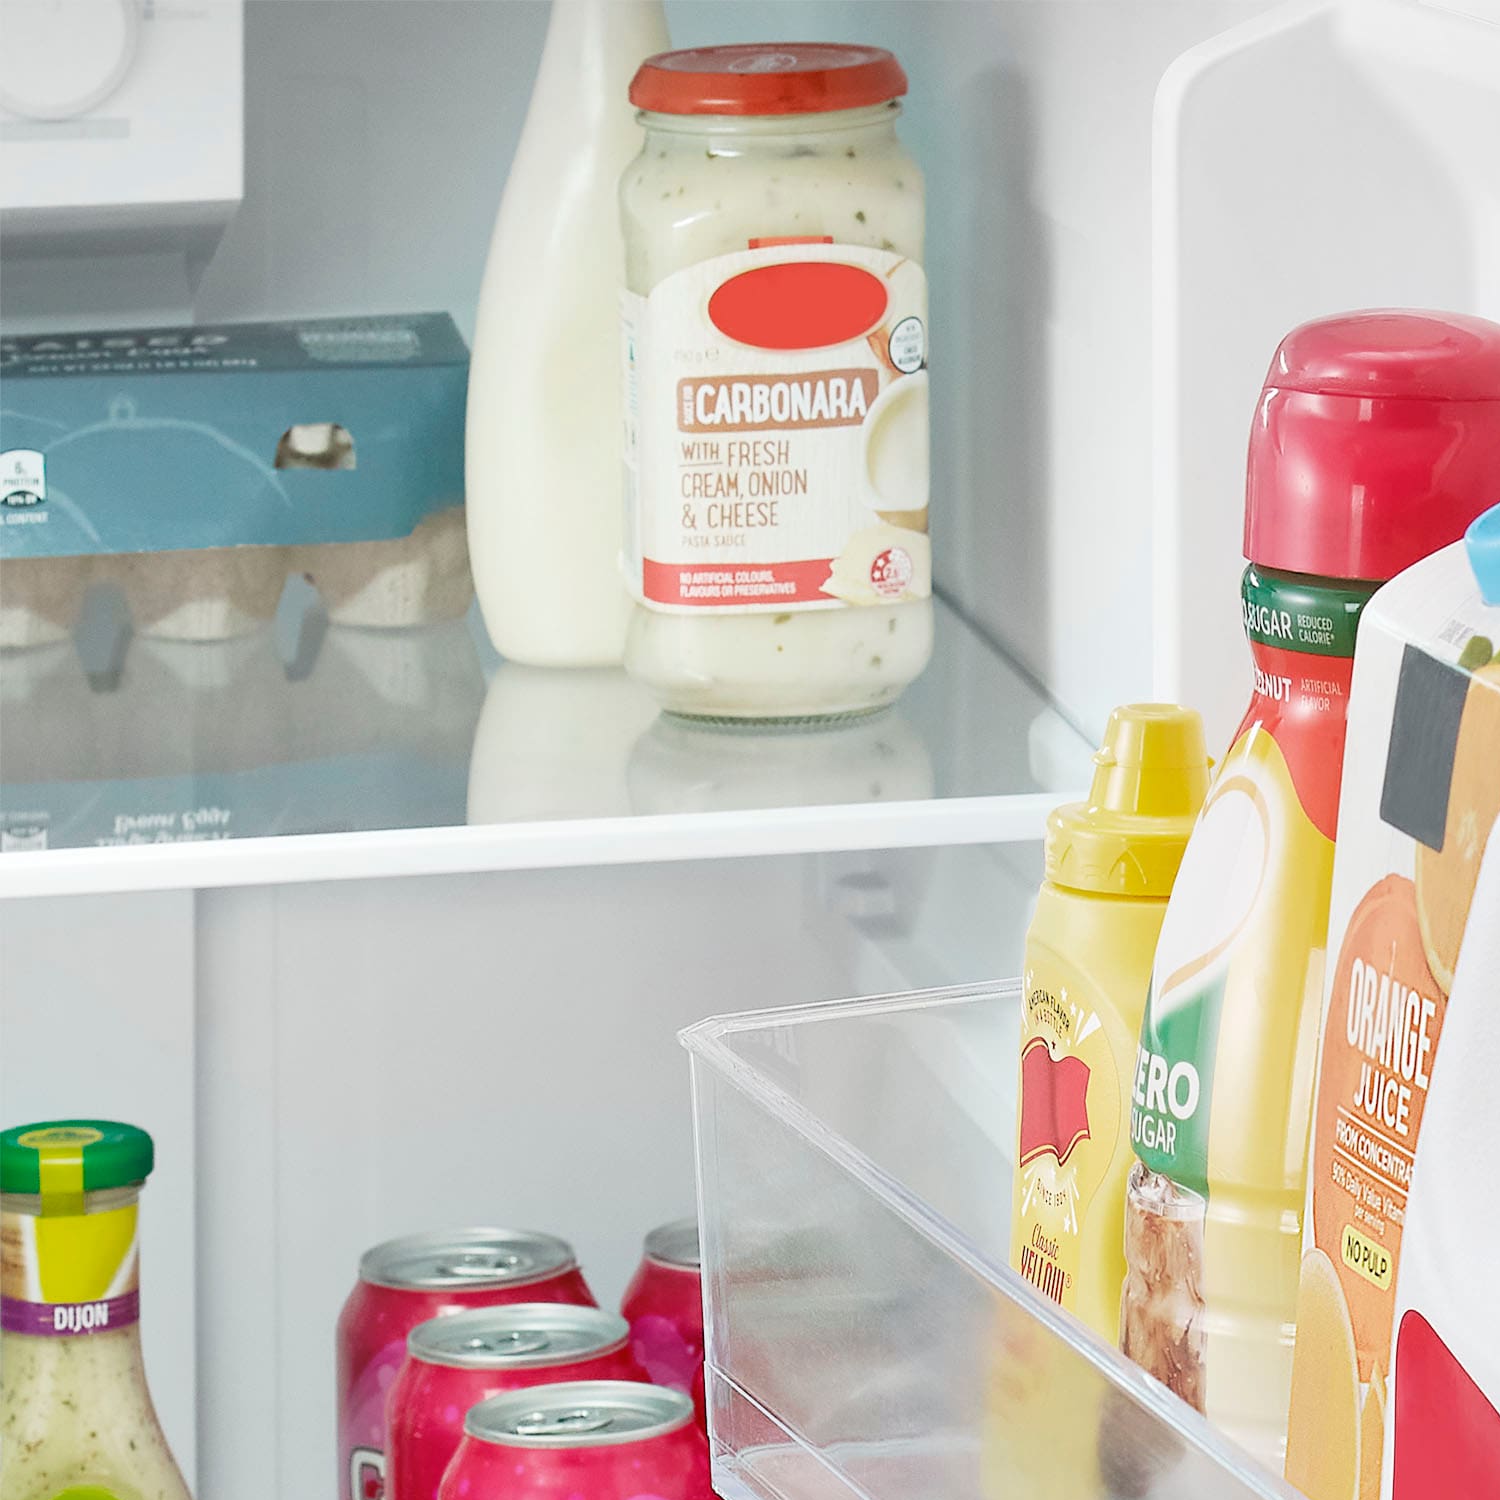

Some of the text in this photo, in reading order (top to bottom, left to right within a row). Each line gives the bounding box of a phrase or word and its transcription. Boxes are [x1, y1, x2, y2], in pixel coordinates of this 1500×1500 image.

[696, 377, 868, 425] CARBONARA
[681, 440, 789, 467] WITH FRESH
[681, 469, 808, 500] CREAM, ONION
[681, 501, 779, 530] & CHEESE
[1297, 614, 1334, 630] REDUCED
[1300, 678, 1343, 696] ARTIFICIAL
[1347, 957, 1437, 1092] ORANGE
[1353, 1062, 1413, 1137] JUICE
[1335, 1119, 1359, 1152] FROM
[1345, 1171, 1363, 1200] Daily
[1362, 1183, 1384, 1212] Value
[1031, 1223, 1059, 1261] Classic
[1346, 1236, 1388, 1280] NO PULP
[54, 1303, 109, 1332] DIJON
